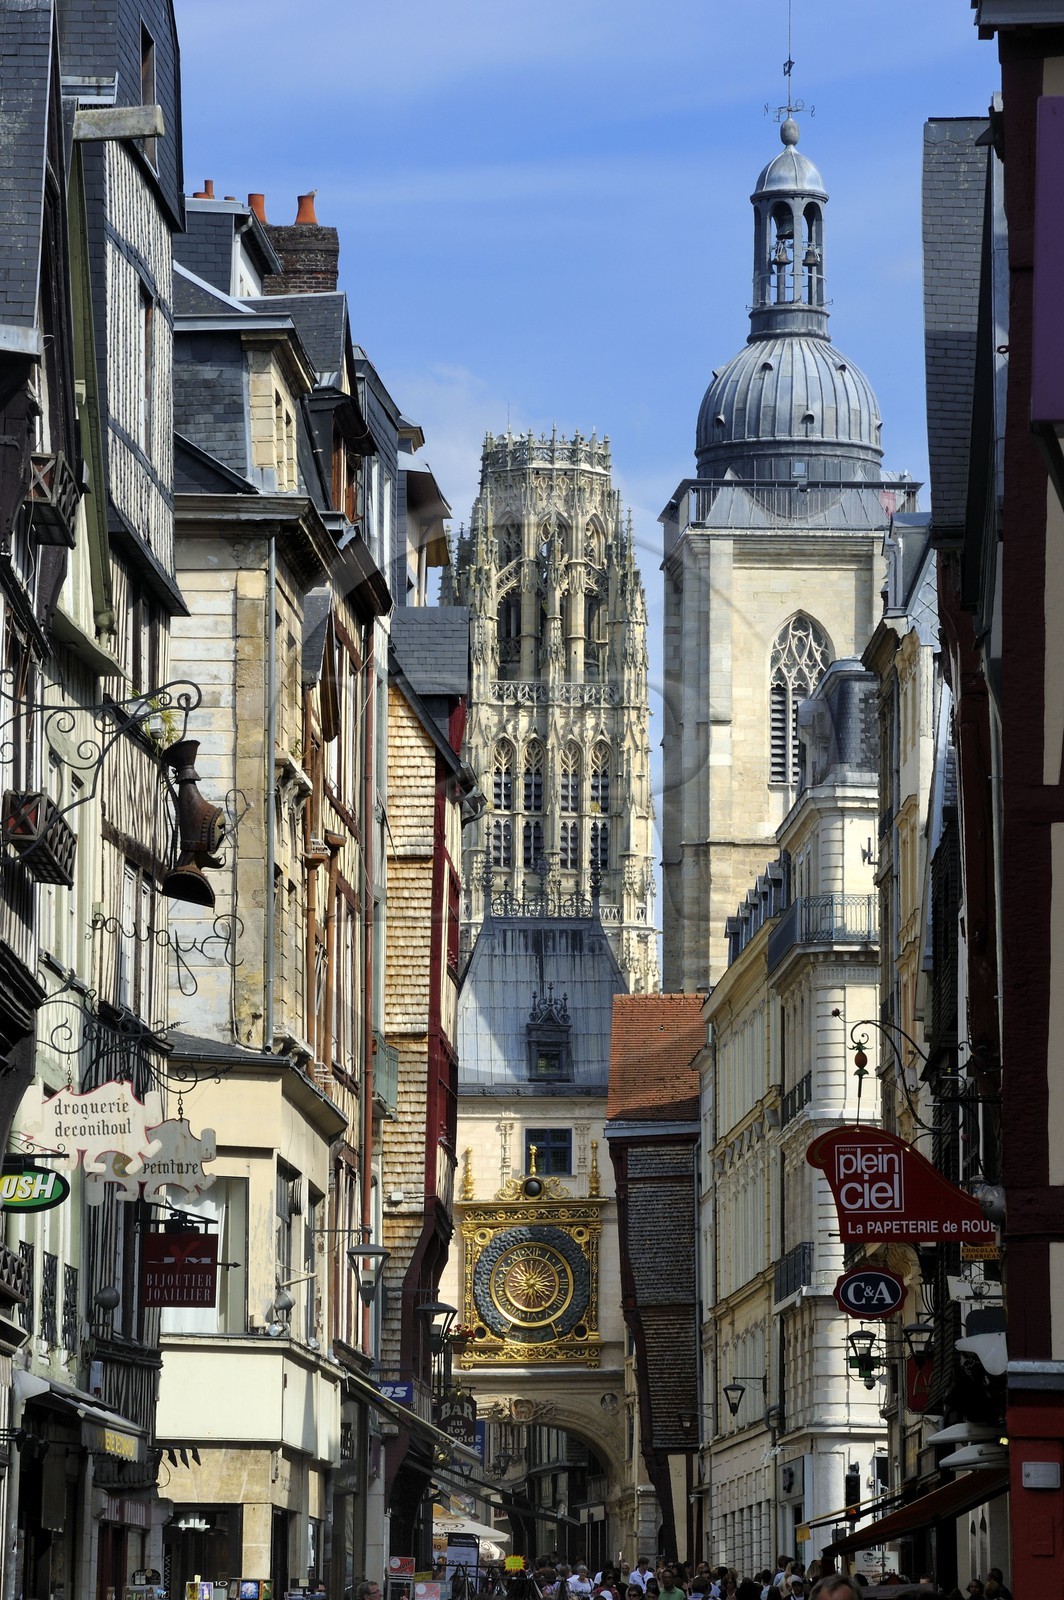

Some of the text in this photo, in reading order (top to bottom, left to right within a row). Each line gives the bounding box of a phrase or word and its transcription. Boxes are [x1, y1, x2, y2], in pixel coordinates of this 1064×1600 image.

[54, 1098, 130, 1120] droguerie
[54, 1118, 132, 1137] deconihout
[142, 1159, 198, 1175] peinture
[839, 1147, 899, 1180] plein
[839, 1174, 900, 1210] ciel
[847, 1221, 864, 1234] La
[866, 1220, 939, 1234] PAPETERIE
[942, 1220, 958, 1233] de
[146, 1273, 212, 1287] BIJOUTIER
[146, 1288, 211, 1302] JOAILLIER
[847, 1281, 894, 1305] C&A
[377, 1386, 408, 1398] BS
[440, 1401, 474, 1422] BAR
[447, 1426, 467, 1435] Roy
